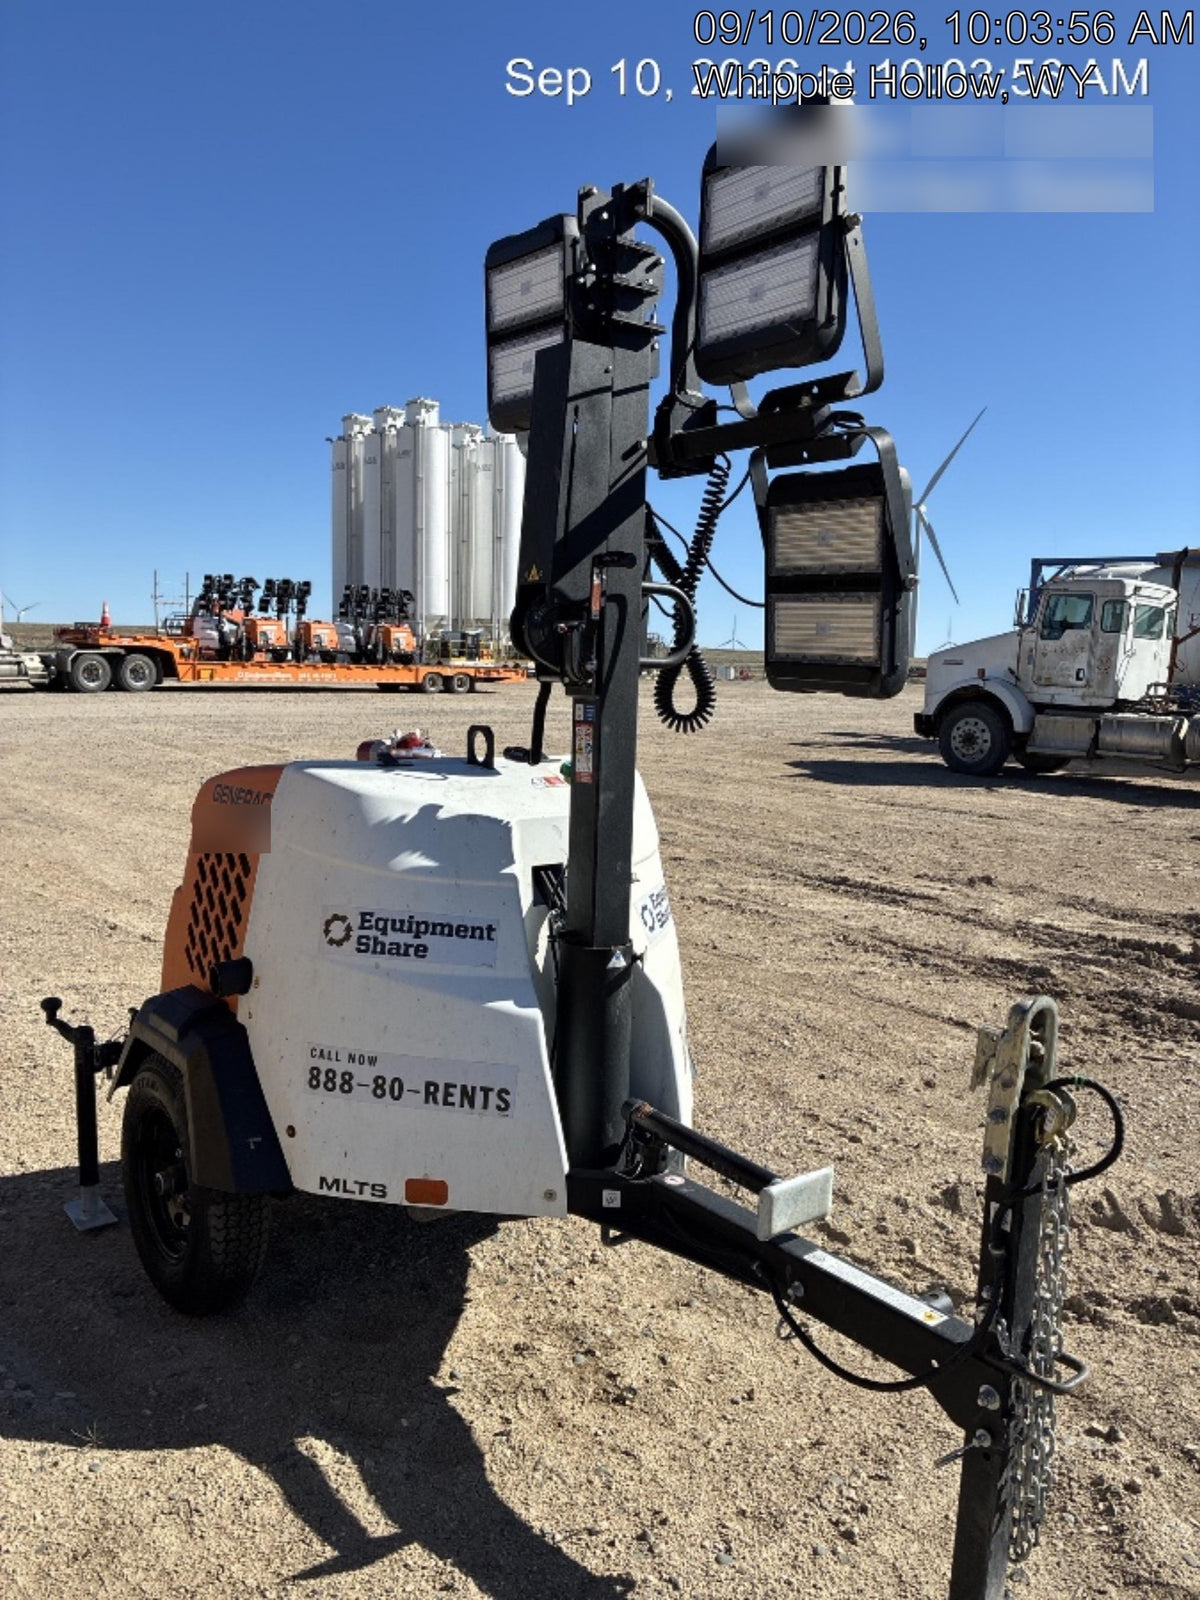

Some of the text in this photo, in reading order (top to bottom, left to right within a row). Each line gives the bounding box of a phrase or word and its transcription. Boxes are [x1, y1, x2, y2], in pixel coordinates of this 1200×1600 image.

[358, 911, 496, 941] Equipment
[355, 934, 429, 959] Share
[310, 1047, 378, 1067] CALL NOW
[308, 1066, 511, 1112] 888-80-RENTS
[319, 1176, 387, 1199] MLTS
